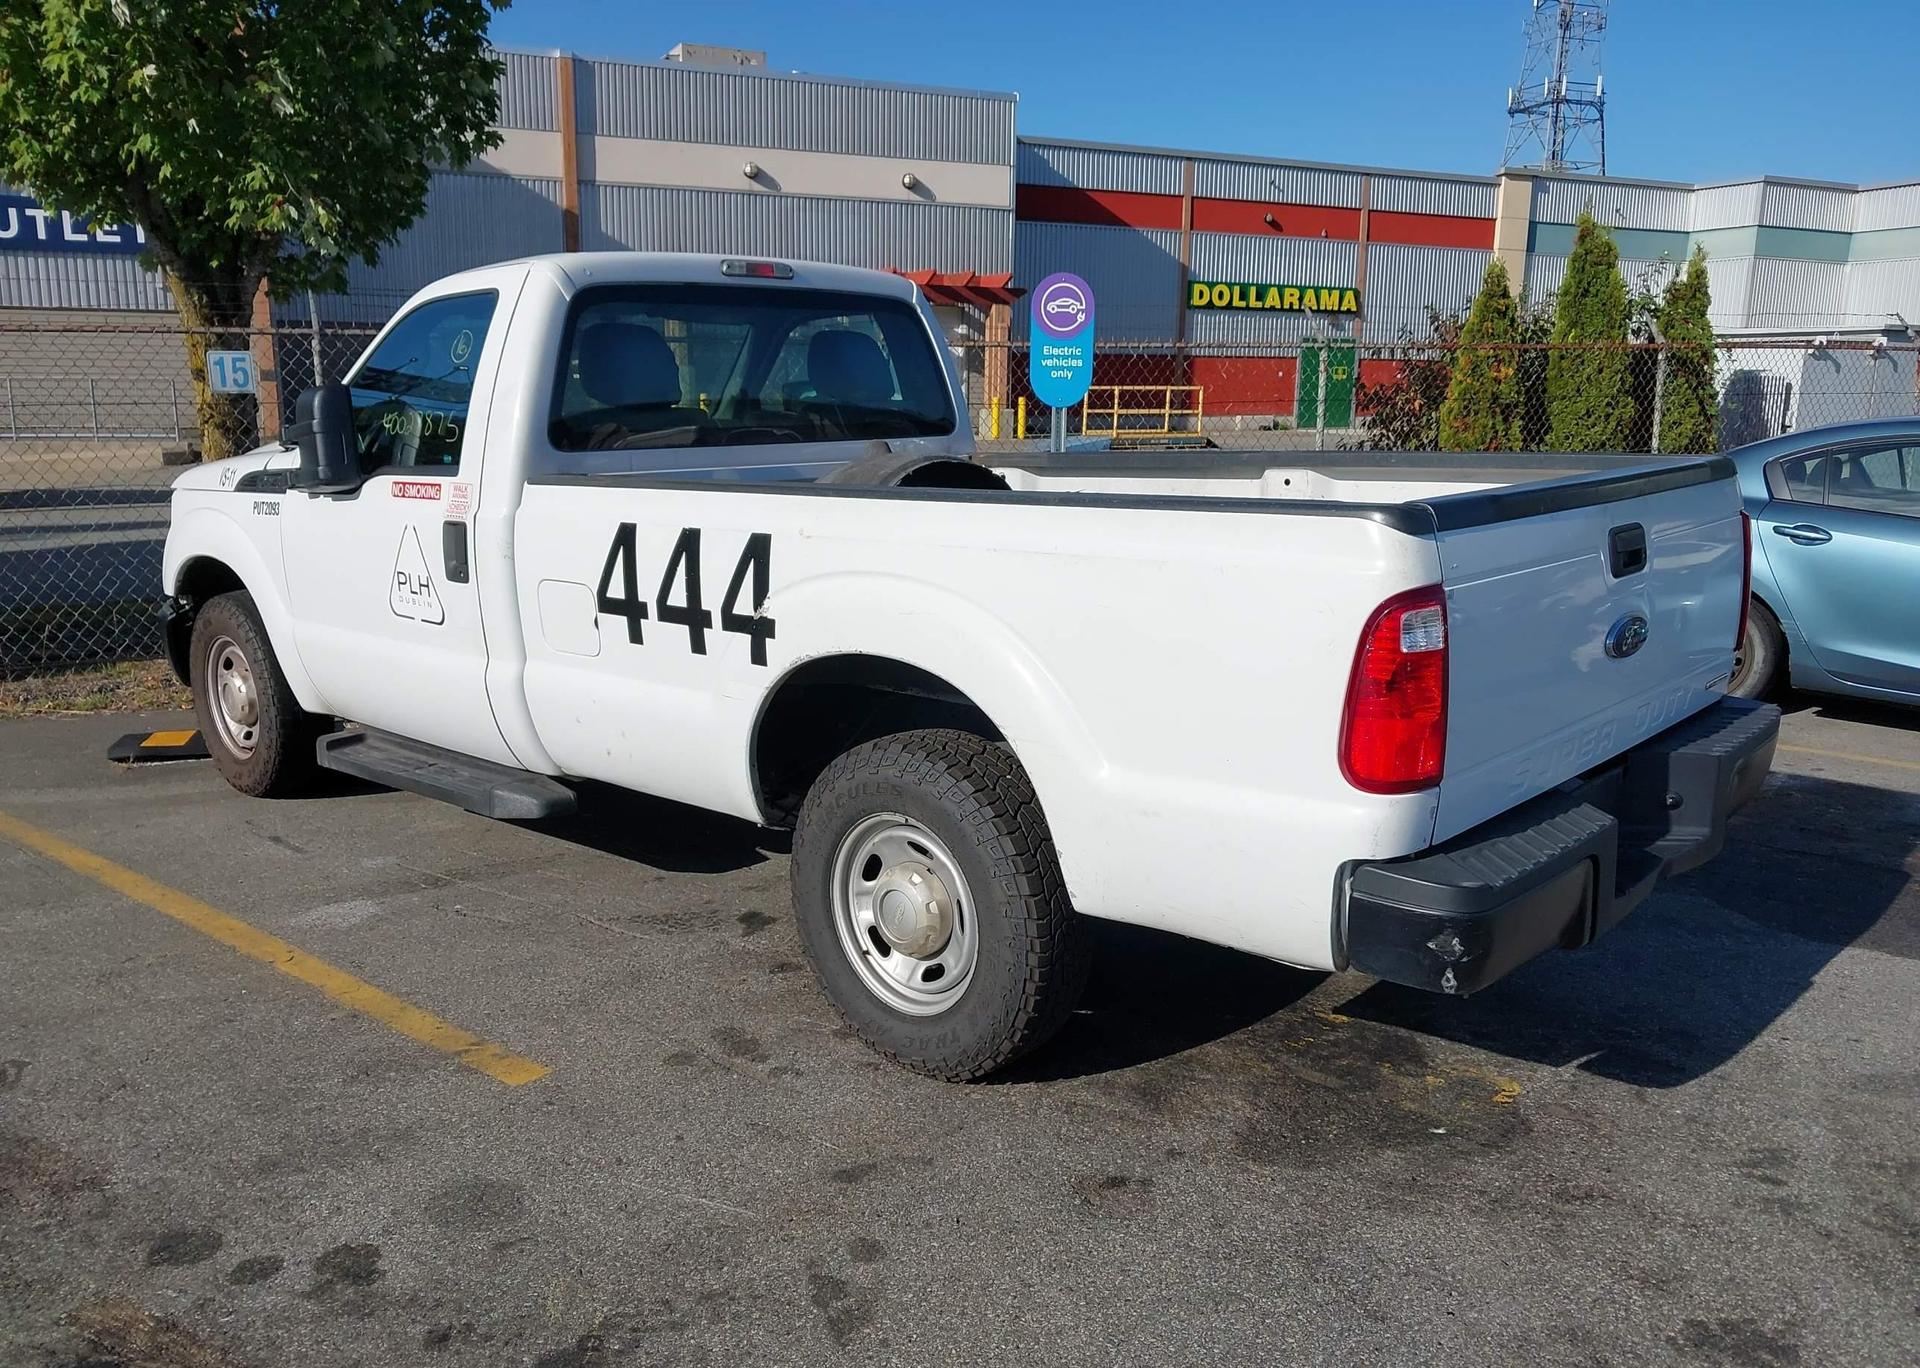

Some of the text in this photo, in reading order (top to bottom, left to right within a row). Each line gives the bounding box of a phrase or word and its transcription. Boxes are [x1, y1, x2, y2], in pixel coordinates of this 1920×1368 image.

[1191, 283, 1358, 312] DOLLARAMA
[1043, 345, 1082, 356] Electric
[1041, 357, 1083, 367] vehicles
[213, 356, 250, 389] 15
[1051, 368, 1073, 380] only
[393, 484, 440, 499] NO SMOKING
[454, 485, 469, 493] WALK
[253, 501, 280, 516] PUT2093
[397, 571, 431, 598] PLH
[399, 595, 433, 609] DUBLIN
[597, 522, 776, 667] 444
[1633, 688, 1695, 736] DUTY
